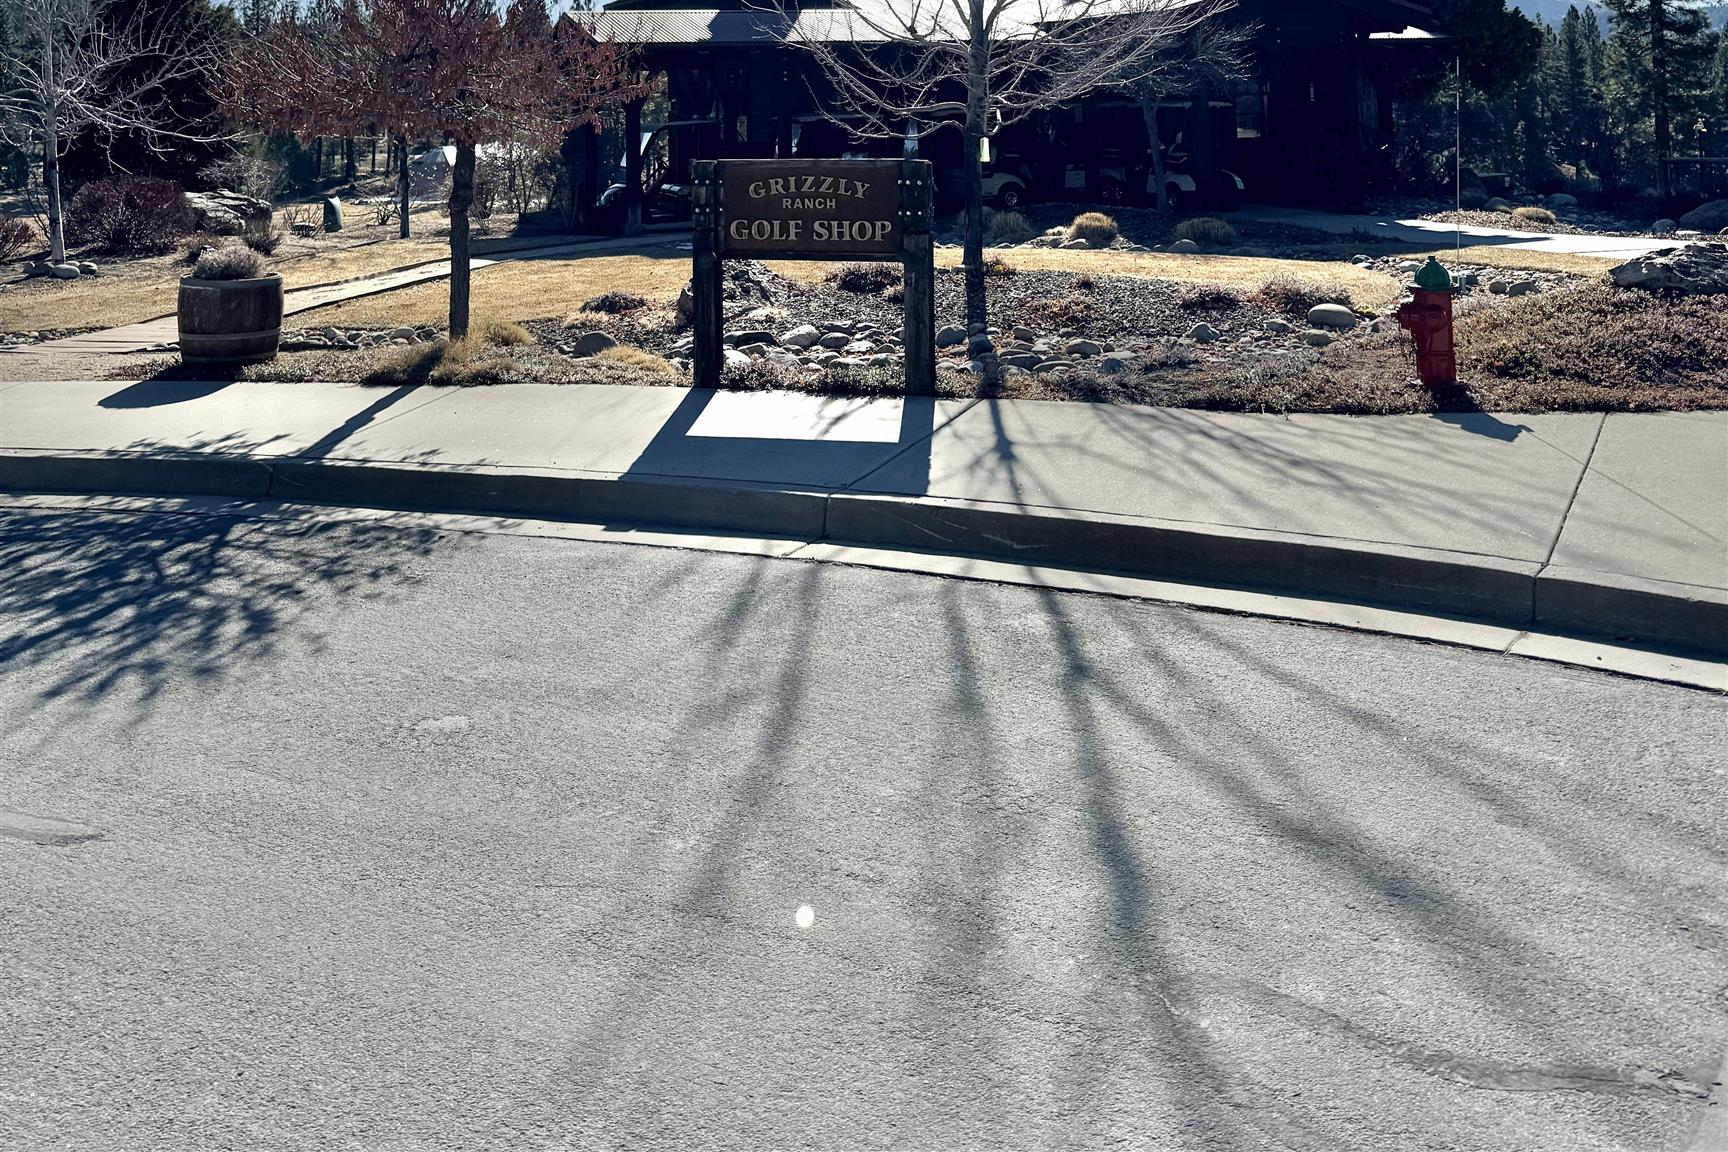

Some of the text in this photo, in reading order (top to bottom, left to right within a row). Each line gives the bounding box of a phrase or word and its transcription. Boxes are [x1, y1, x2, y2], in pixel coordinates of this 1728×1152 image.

[749, 176, 871, 198] GRIZZLY
[782, 198, 836, 209] RANCH
[730, 219, 892, 242] GOLF SHOP
